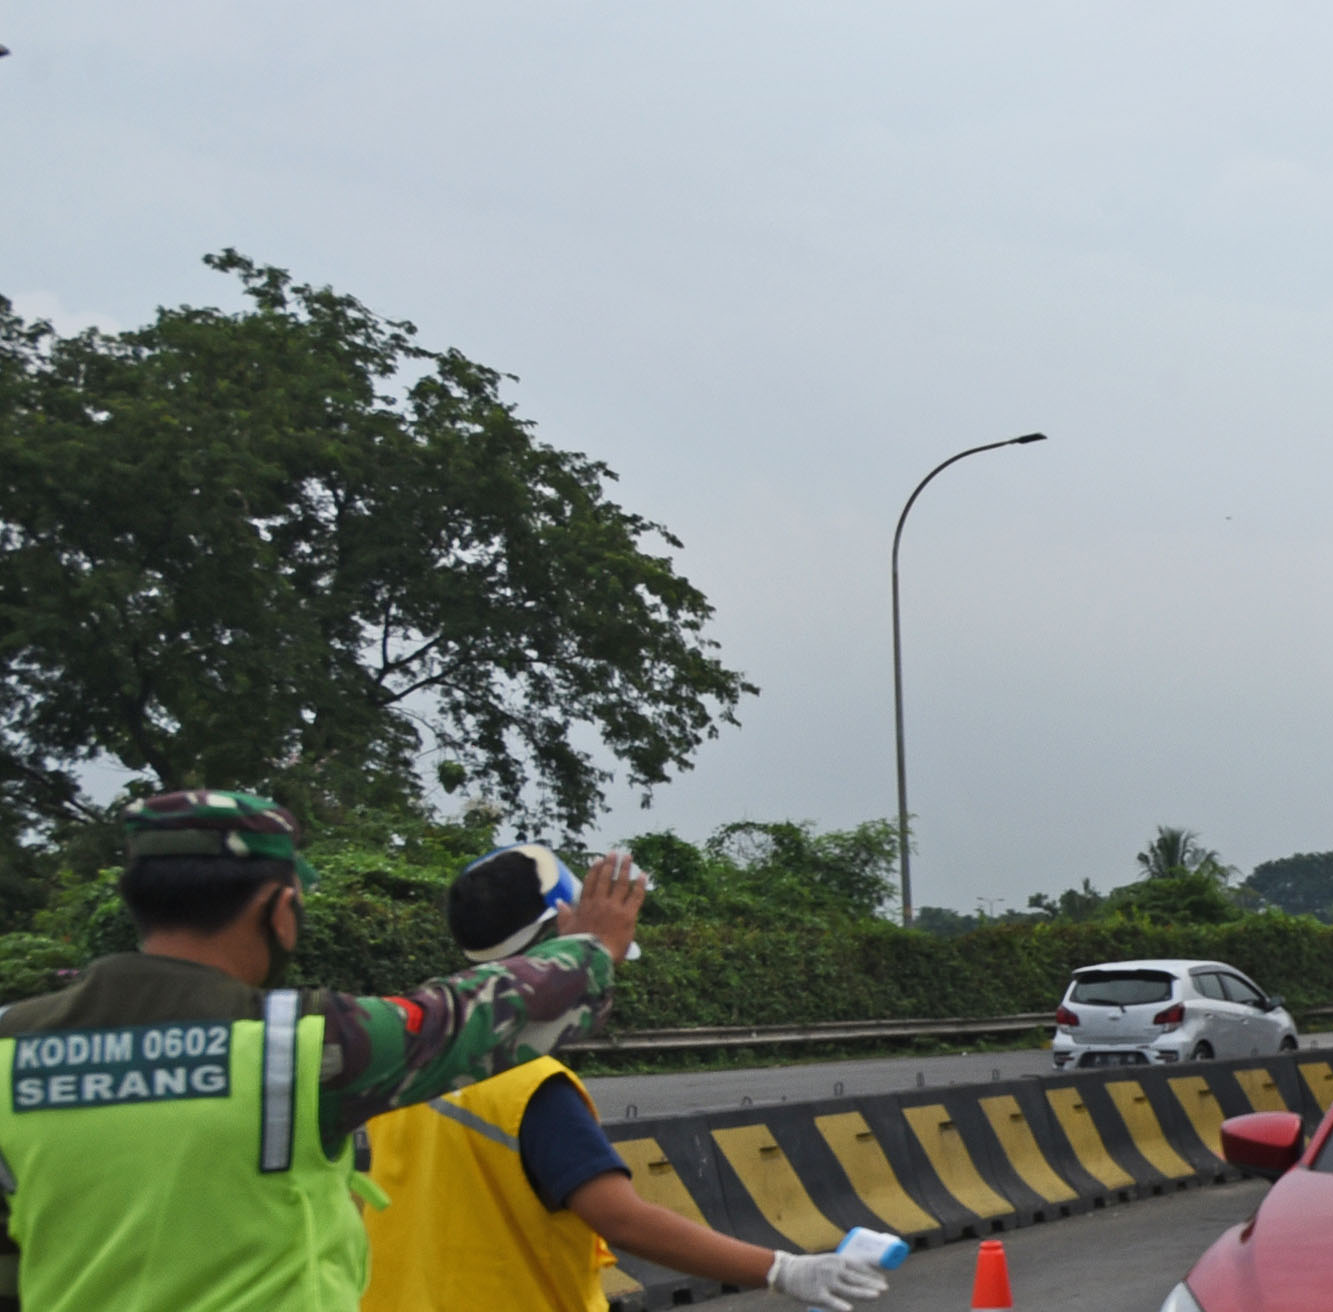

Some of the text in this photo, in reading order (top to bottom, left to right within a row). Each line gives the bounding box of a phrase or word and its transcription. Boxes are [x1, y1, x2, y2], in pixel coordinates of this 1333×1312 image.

[17, 1026, 228, 1069] KODIM 0602
[16, 1064, 227, 1106] SERANG
